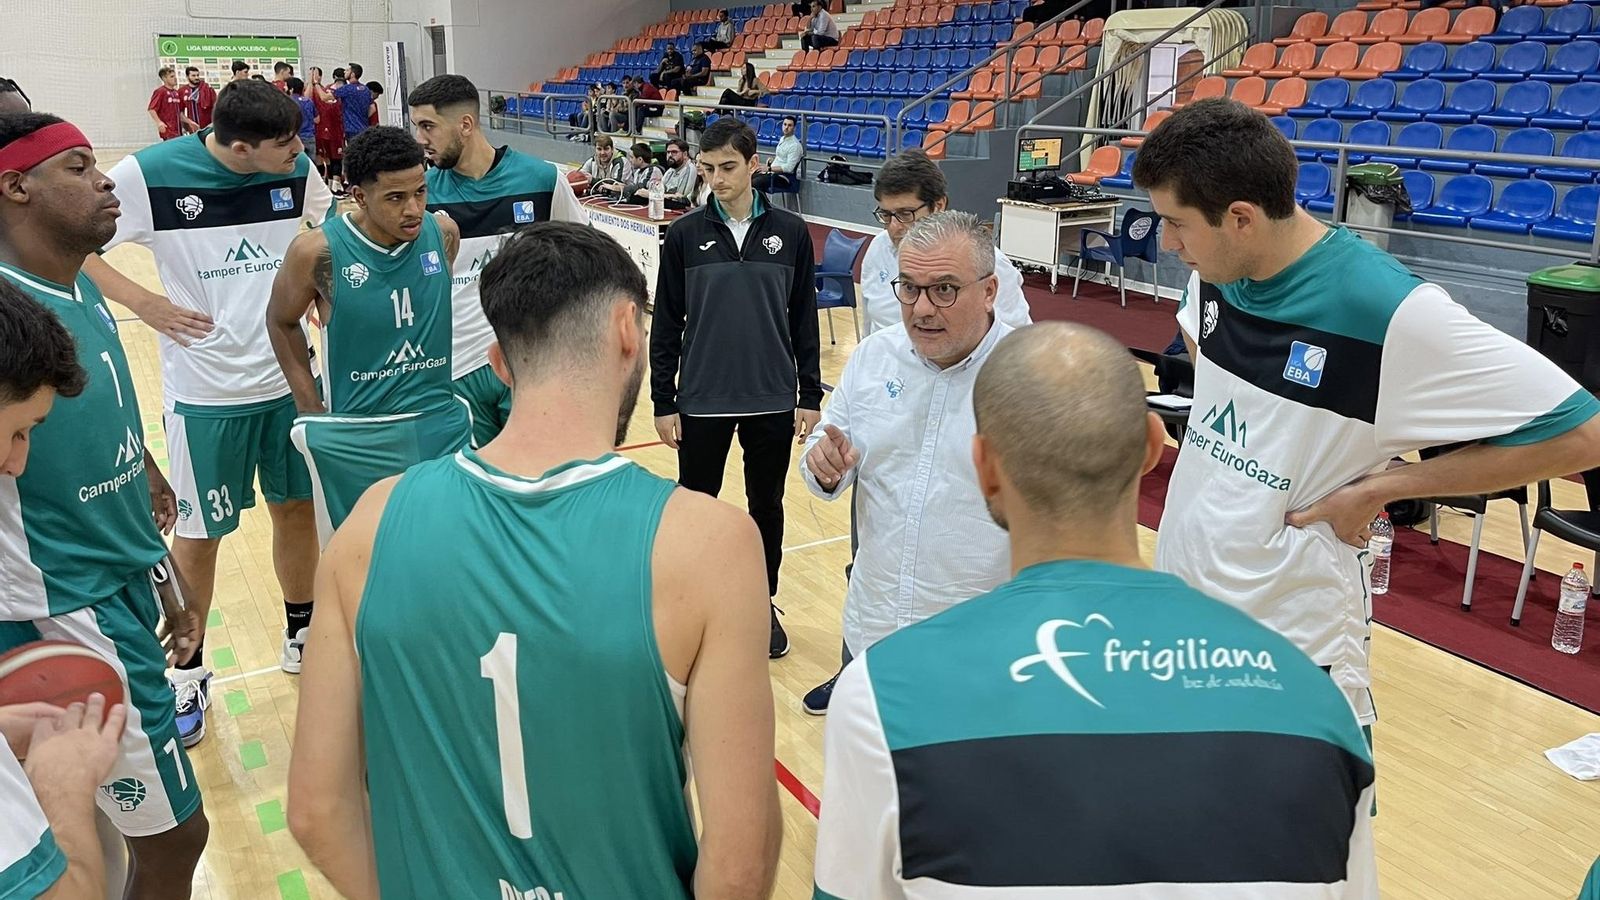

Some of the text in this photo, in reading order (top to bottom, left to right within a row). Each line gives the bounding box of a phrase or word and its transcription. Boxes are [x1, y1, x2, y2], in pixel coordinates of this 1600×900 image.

[589, 211, 656, 237] AYUNTAMIENTO DOS HERMANAS
[390, 287, 414, 329] 14
[100, 351, 123, 408] 1
[350, 355, 447, 382] Camper EuroGaza
[1287, 366, 1310, 383] EBA
[78, 469, 132, 503] Camper
[1210, 440, 1292, 492] EuroGaza
[207, 484, 234, 522] 33
[1103, 637, 1277, 681] frigiliana
[479, 631, 533, 840] 1
[163, 737, 188, 791] 1
